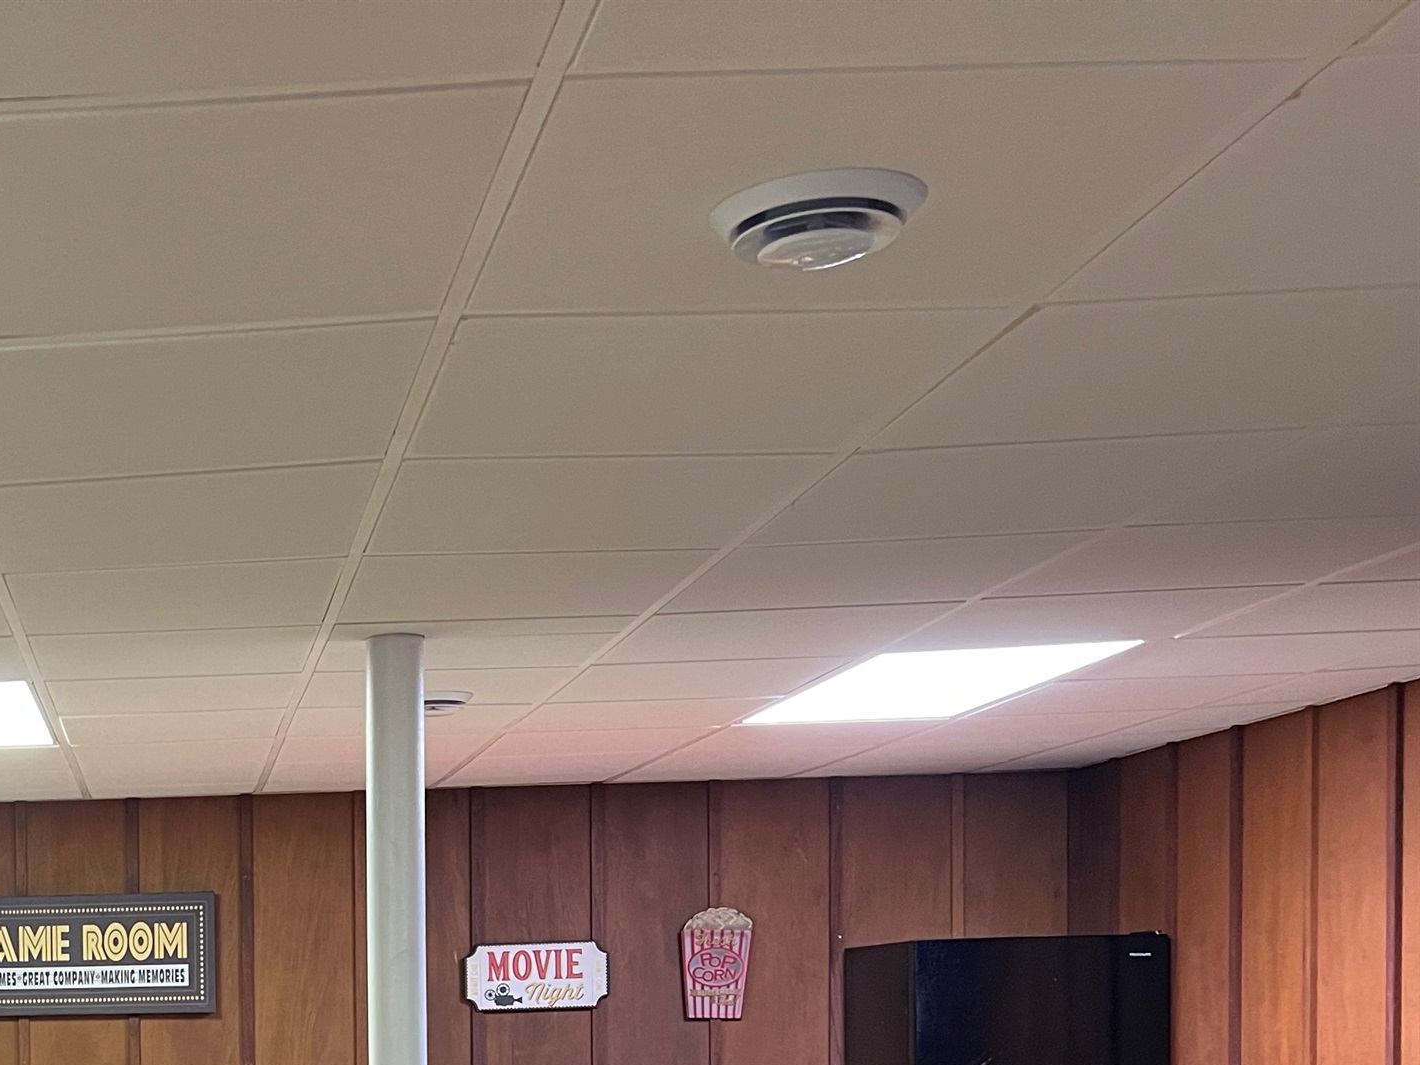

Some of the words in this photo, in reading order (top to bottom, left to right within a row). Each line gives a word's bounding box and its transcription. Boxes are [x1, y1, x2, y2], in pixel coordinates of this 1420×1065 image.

[82, 921, 188, 962] ROOM
[487, 948, 583, 982] MOVIE
[700, 952, 737, 969] POP
[22, 971, 50, 986] GREAT
[53, 970, 95, 986] COMPANY
[101, 969, 135, 985] MAKING
[138, 968, 185, 984] MEMORIES
[692, 967, 737, 982] CORN
[525, 981, 585, 1007] Night
